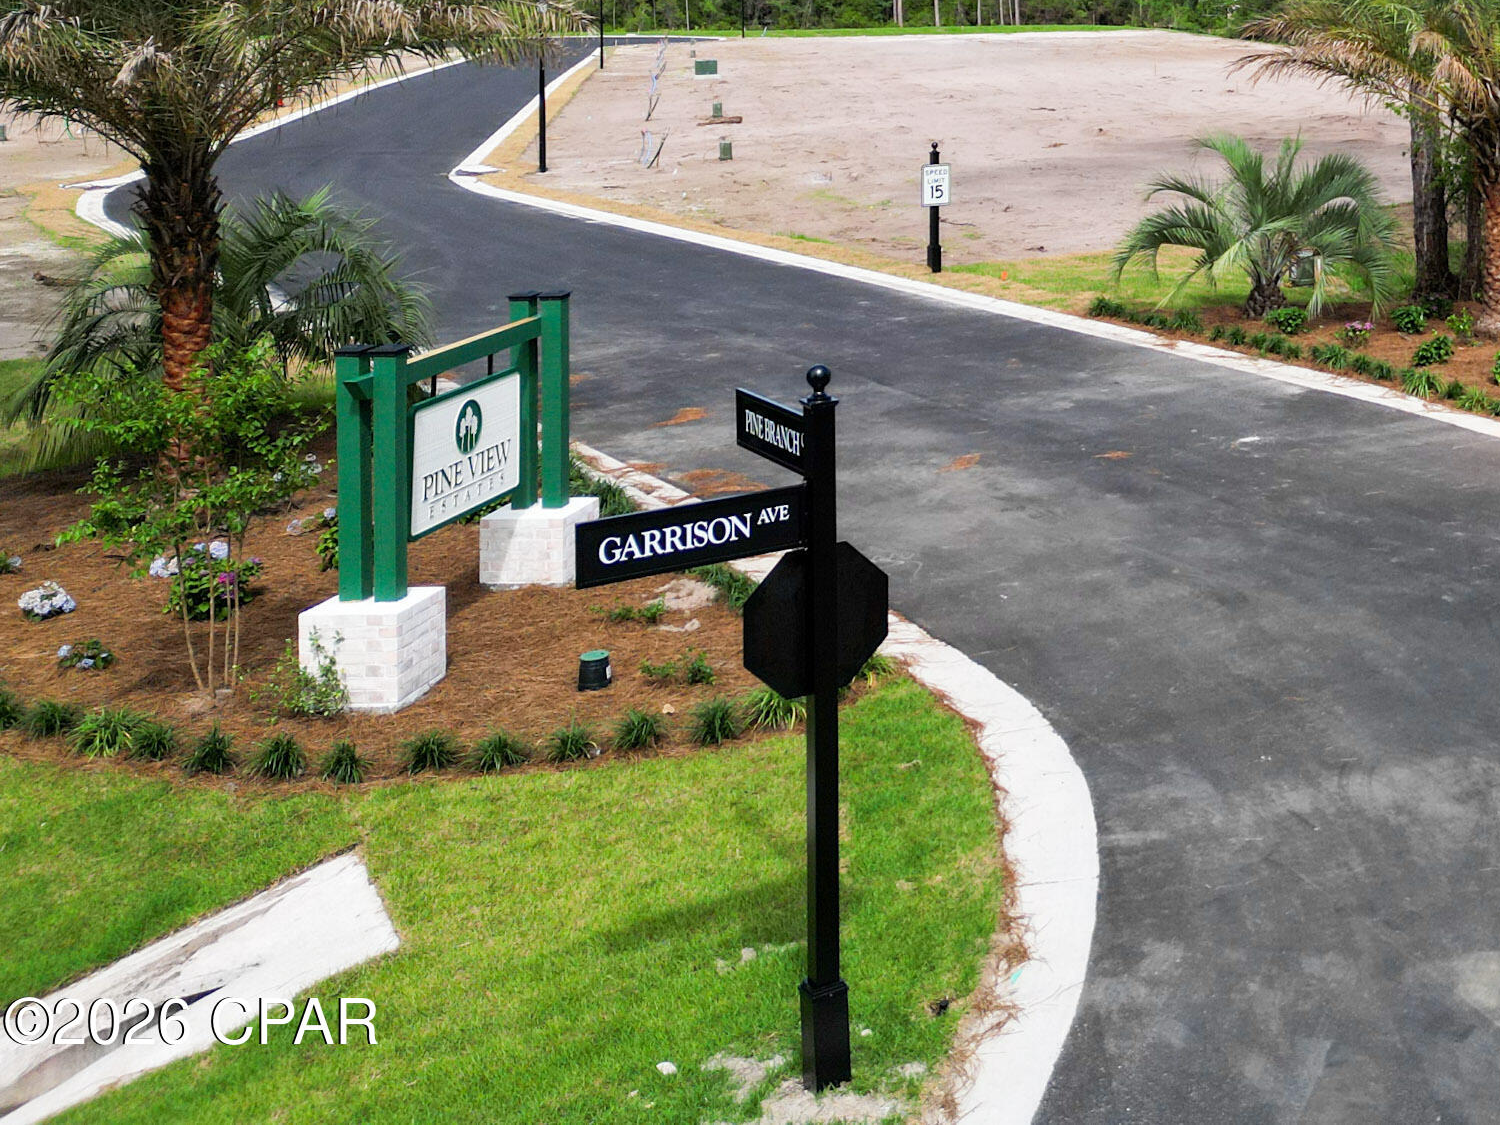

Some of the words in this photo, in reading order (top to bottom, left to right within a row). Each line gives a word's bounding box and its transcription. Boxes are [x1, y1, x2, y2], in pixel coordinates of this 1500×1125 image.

[930, 184, 944, 199] 15
[745, 409, 764, 440] PINE
[764, 418, 800, 456] BRANCH
[422, 460, 463, 501] PINE
[468, 438, 511, 480] VIEW
[428, 473, 505, 520] ESTATES
[598, 513, 753, 565] GARRISON
[757, 504, 790, 525] AVE
